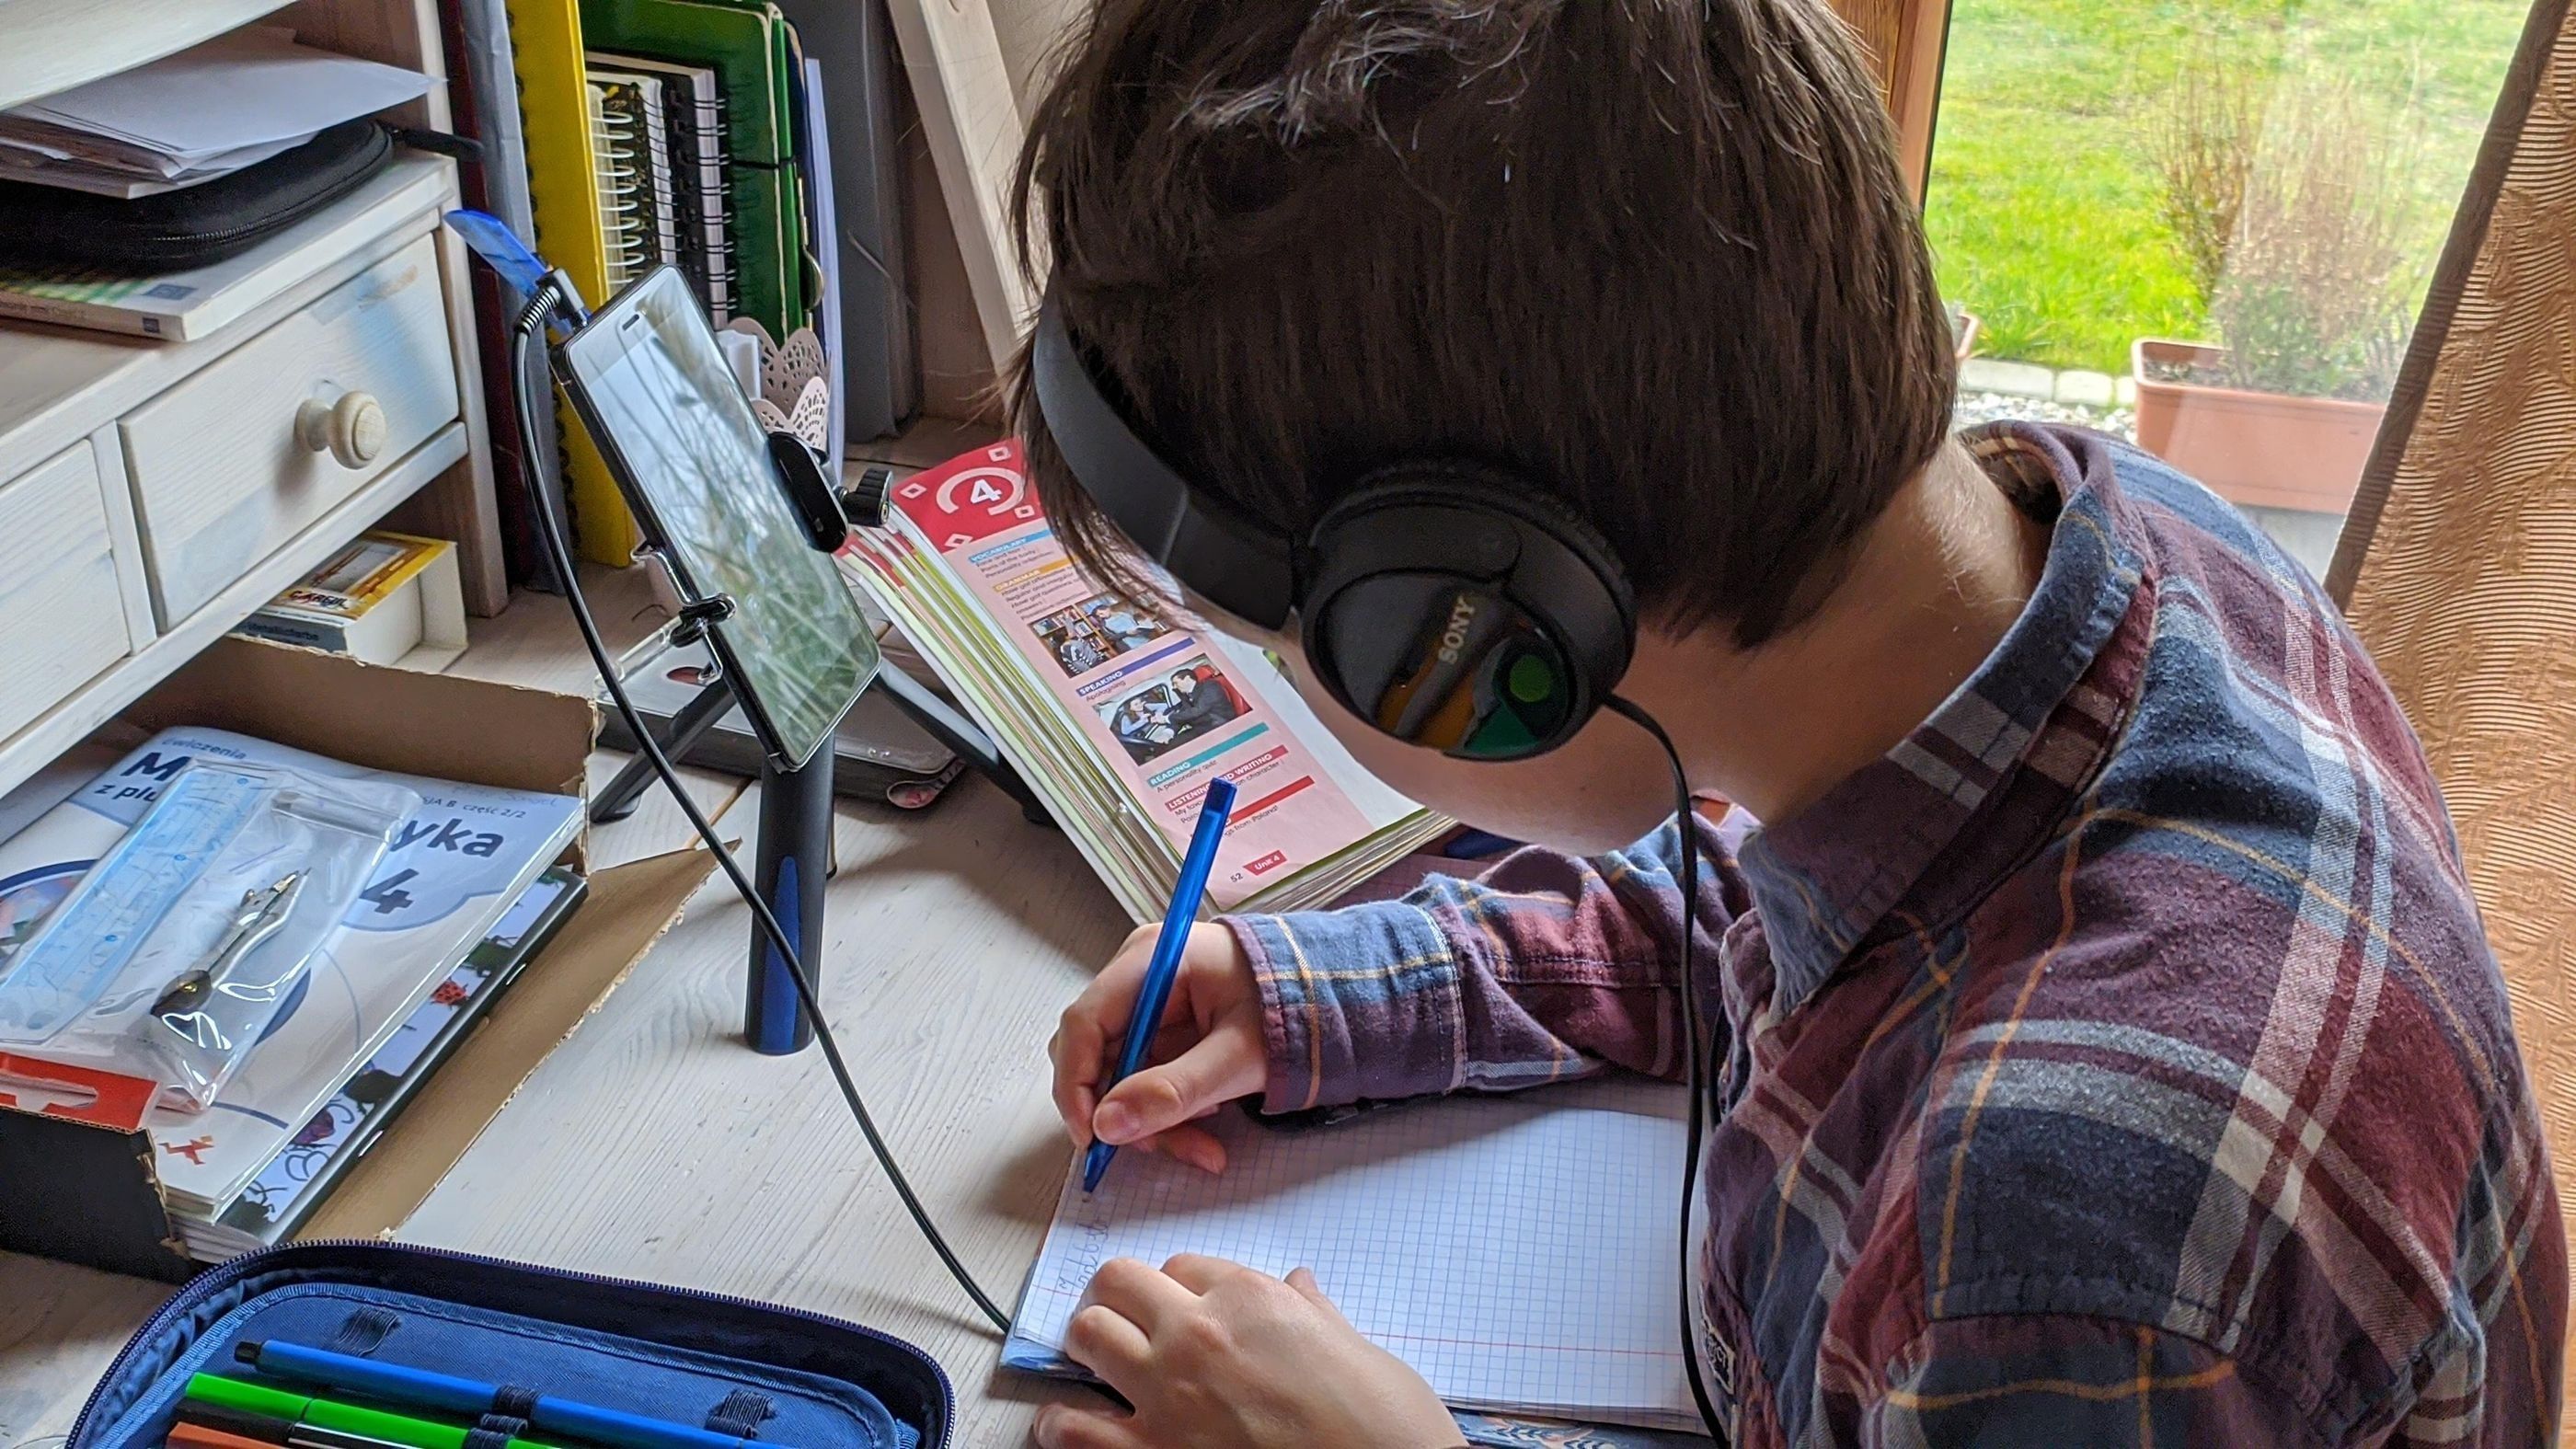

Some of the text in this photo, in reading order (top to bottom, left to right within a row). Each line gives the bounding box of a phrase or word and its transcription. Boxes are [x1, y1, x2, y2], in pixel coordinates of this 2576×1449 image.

[970, 478, 1003, 504] 4
[1438, 595, 1478, 665] SONY
[1079, 671, 1122, 695] SPEAKING
[1150, 761, 1190, 786] READING
[1235, 753, 1272, 776] WRITING
[1164, 767, 1202, 790] personality
[112, 787, 157, 802] plu
[500, 808, 527, 819] 2/2
[389, 818, 504, 857] yka
[1230, 872, 1244, 882] 52
[1254, 858, 1272, 870] Unit
[358, 868, 420, 914] 4
